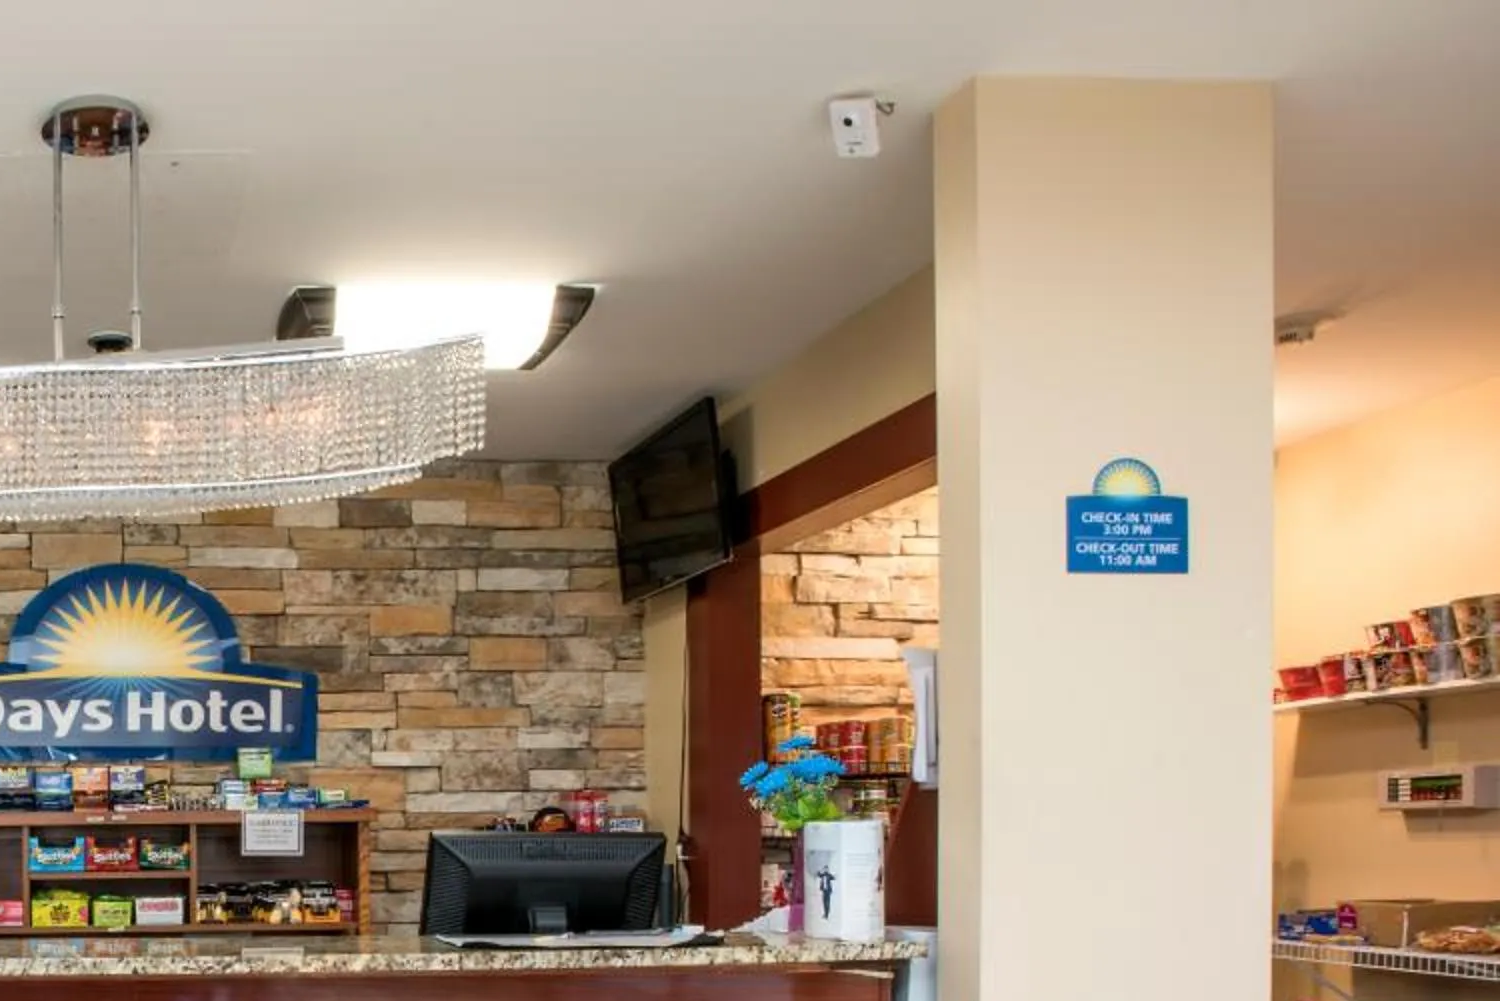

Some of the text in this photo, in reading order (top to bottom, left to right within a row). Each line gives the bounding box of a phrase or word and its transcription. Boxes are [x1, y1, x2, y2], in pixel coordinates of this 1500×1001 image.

[1081, 511, 1173, 524] CHECK-IN TIME
[1103, 524, 1153, 535] 3:00 PM
[1075, 542, 1179, 554] CHECK-OUT TIME
[1100, 555, 1157, 566] 11:00 AM
[127, 689, 283, 733] Hotel
